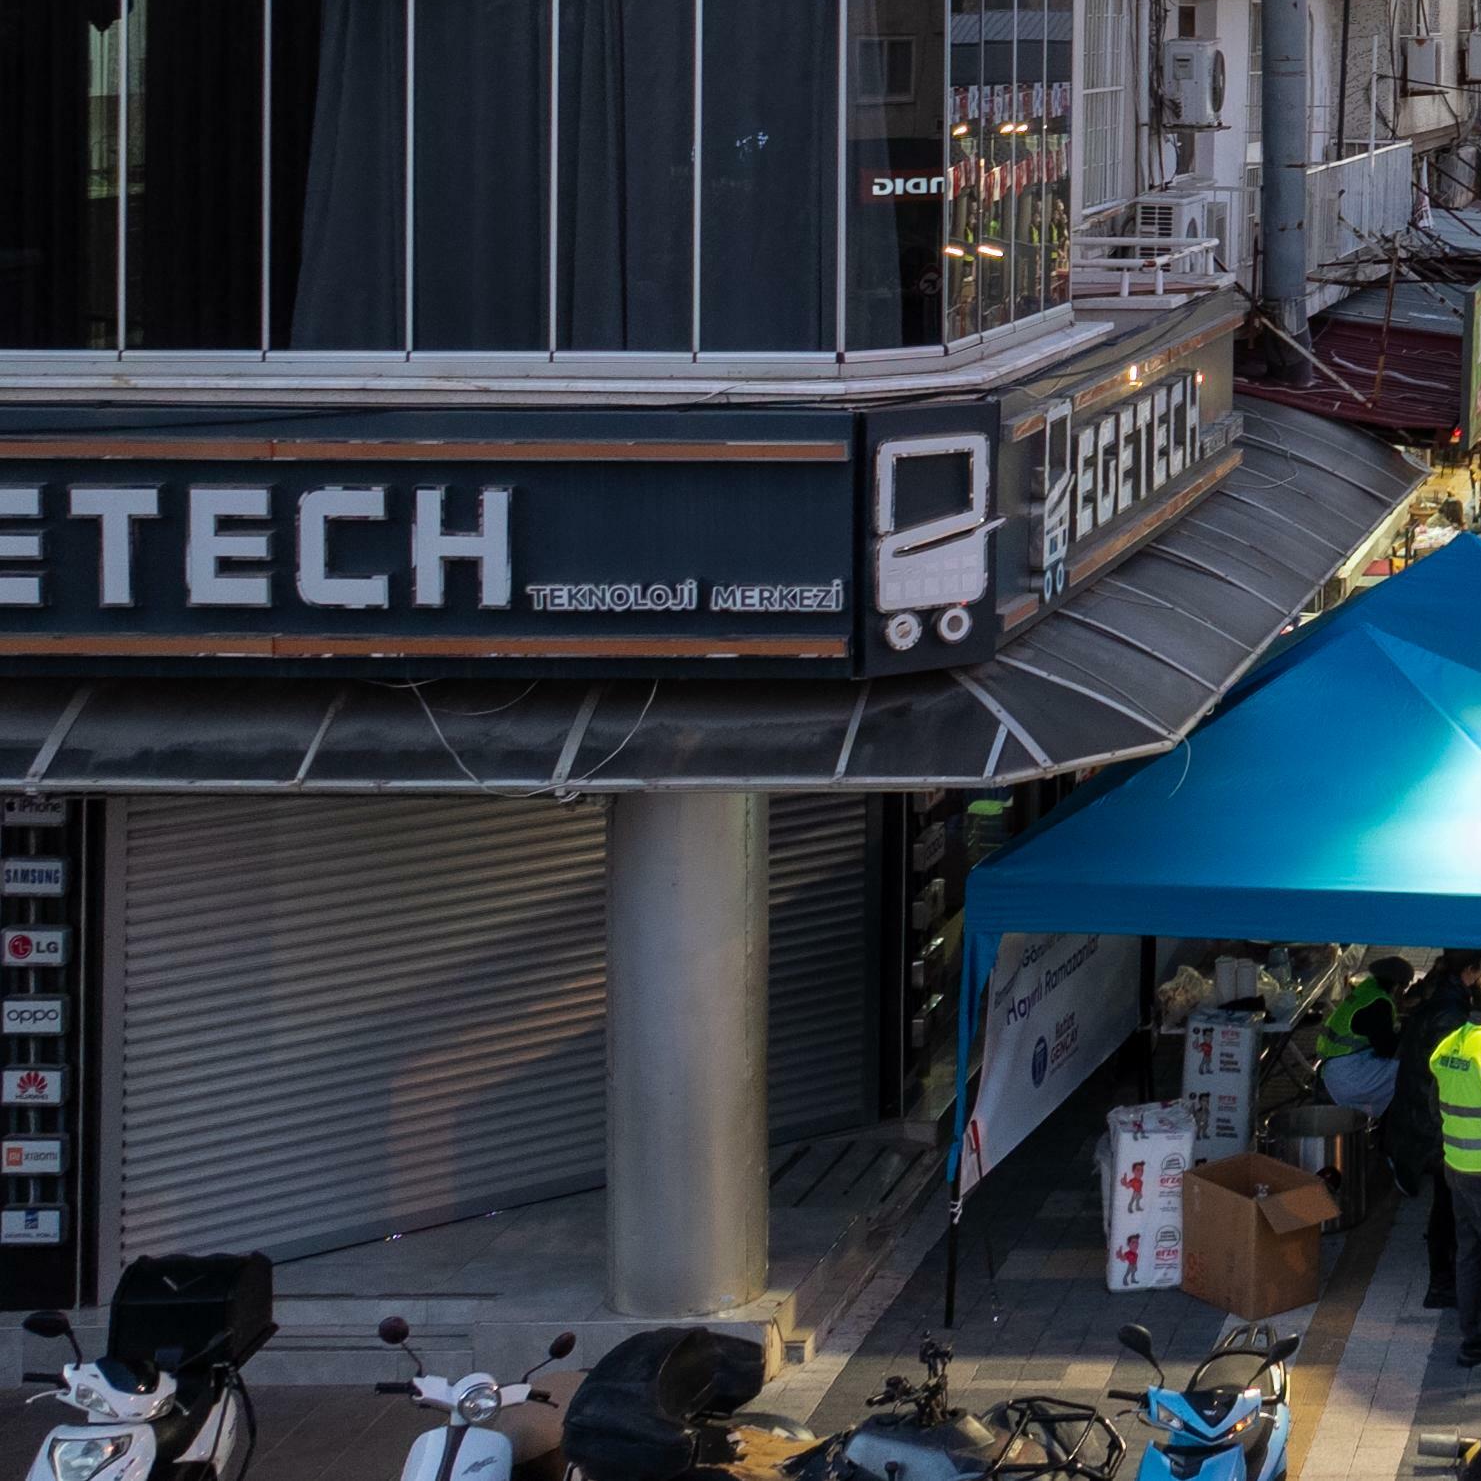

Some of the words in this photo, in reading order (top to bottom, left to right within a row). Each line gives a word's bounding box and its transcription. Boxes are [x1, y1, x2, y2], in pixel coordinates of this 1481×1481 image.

[525, 579, 698, 612] TEKNOLOJİ
[710, 578, 845, 612] MERKEZİ
[4, 868, 61, 885] SAMSUNG
[36, 940, 59, 954] LG
[6, 1009, 59, 1025] oppo
